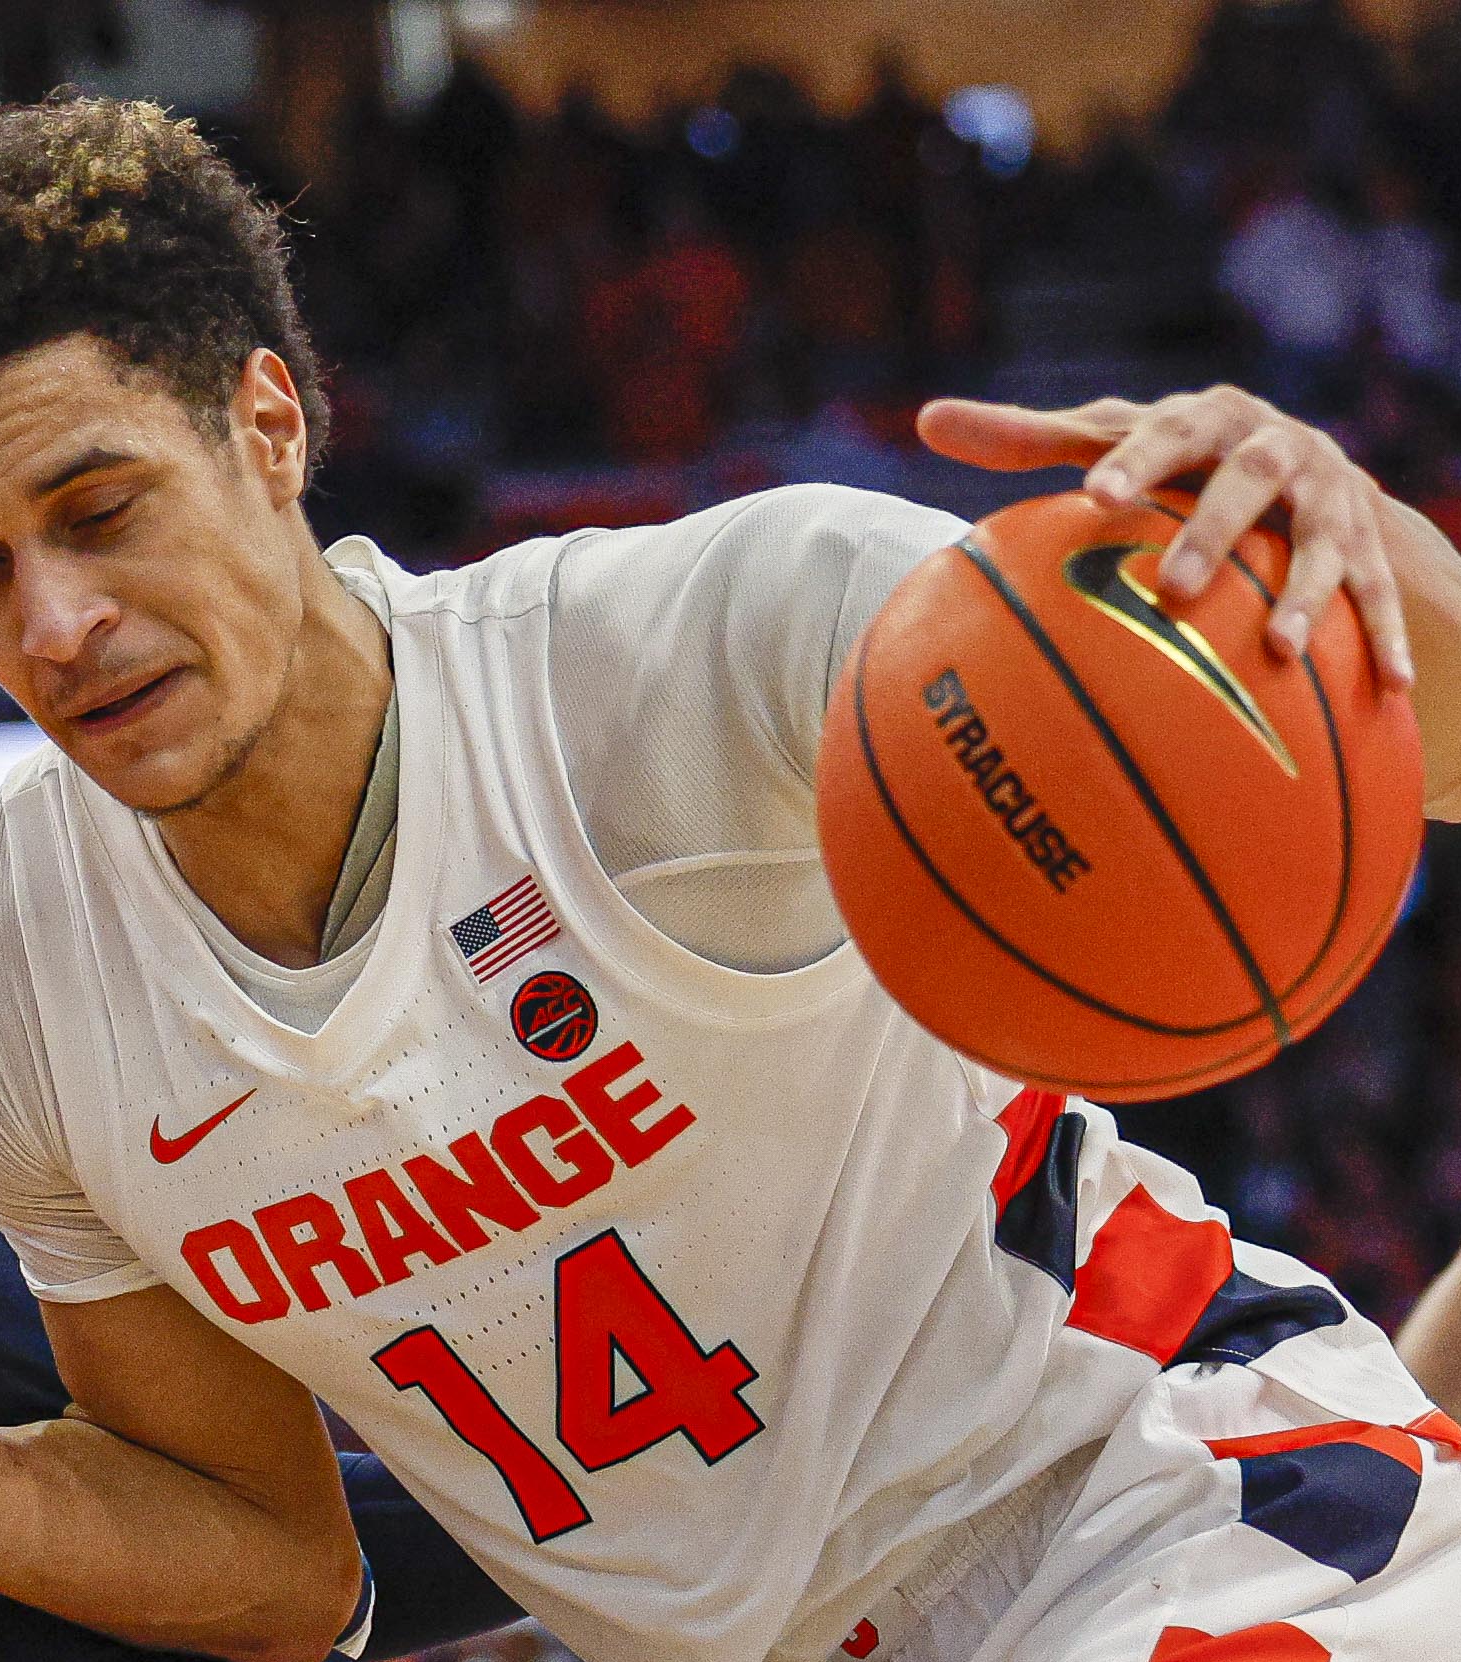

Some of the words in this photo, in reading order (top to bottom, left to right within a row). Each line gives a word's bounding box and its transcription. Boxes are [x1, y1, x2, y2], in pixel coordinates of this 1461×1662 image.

[921, 665, 1094, 894] SYRACUSE
[530, 988, 582, 1033] ACC
[180, 1040, 698, 1325] ORANGE
[370, 1226, 767, 1545] 14
